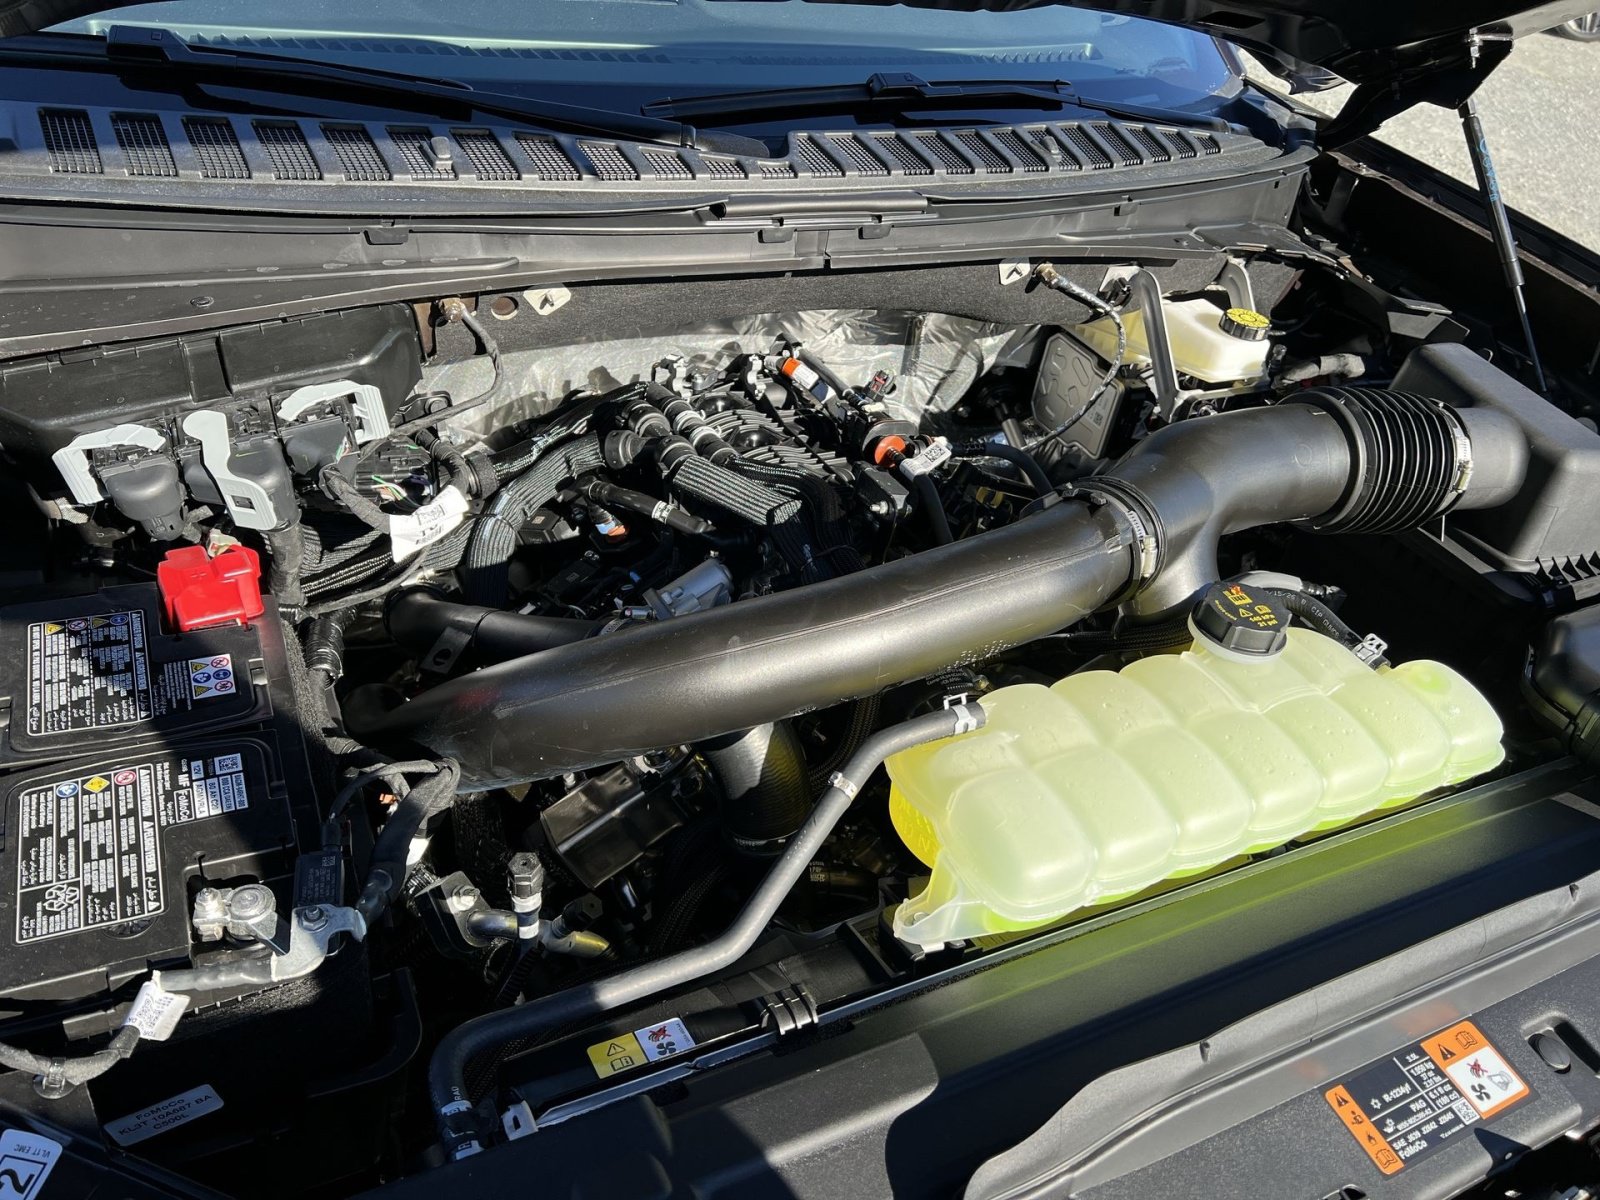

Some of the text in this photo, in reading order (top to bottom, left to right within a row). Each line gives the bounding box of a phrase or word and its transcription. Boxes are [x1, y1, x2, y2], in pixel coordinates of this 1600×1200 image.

[192, 764, 201, 775] 12V
[177, 773, 189, 787] MF
[209, 789, 217, 798] Ah
[177, 790, 190, 820] FoMoCo
[1426, 1061, 1435, 1071] kg
[1382, 1082, 1413, 1103] R-1234yf
[1448, 1091, 1460, 1101] cc)
[194, 1095, 212, 1105] BA
[1410, 1099, 1427, 1112] PAG
[136, 1098, 184, 1120] FoMoCo
[14, 1144, 32, 1153] EMC
[1392, 1138, 1407, 1151] SAE
[1398, 1139, 1428, 1160] FoMoCo
